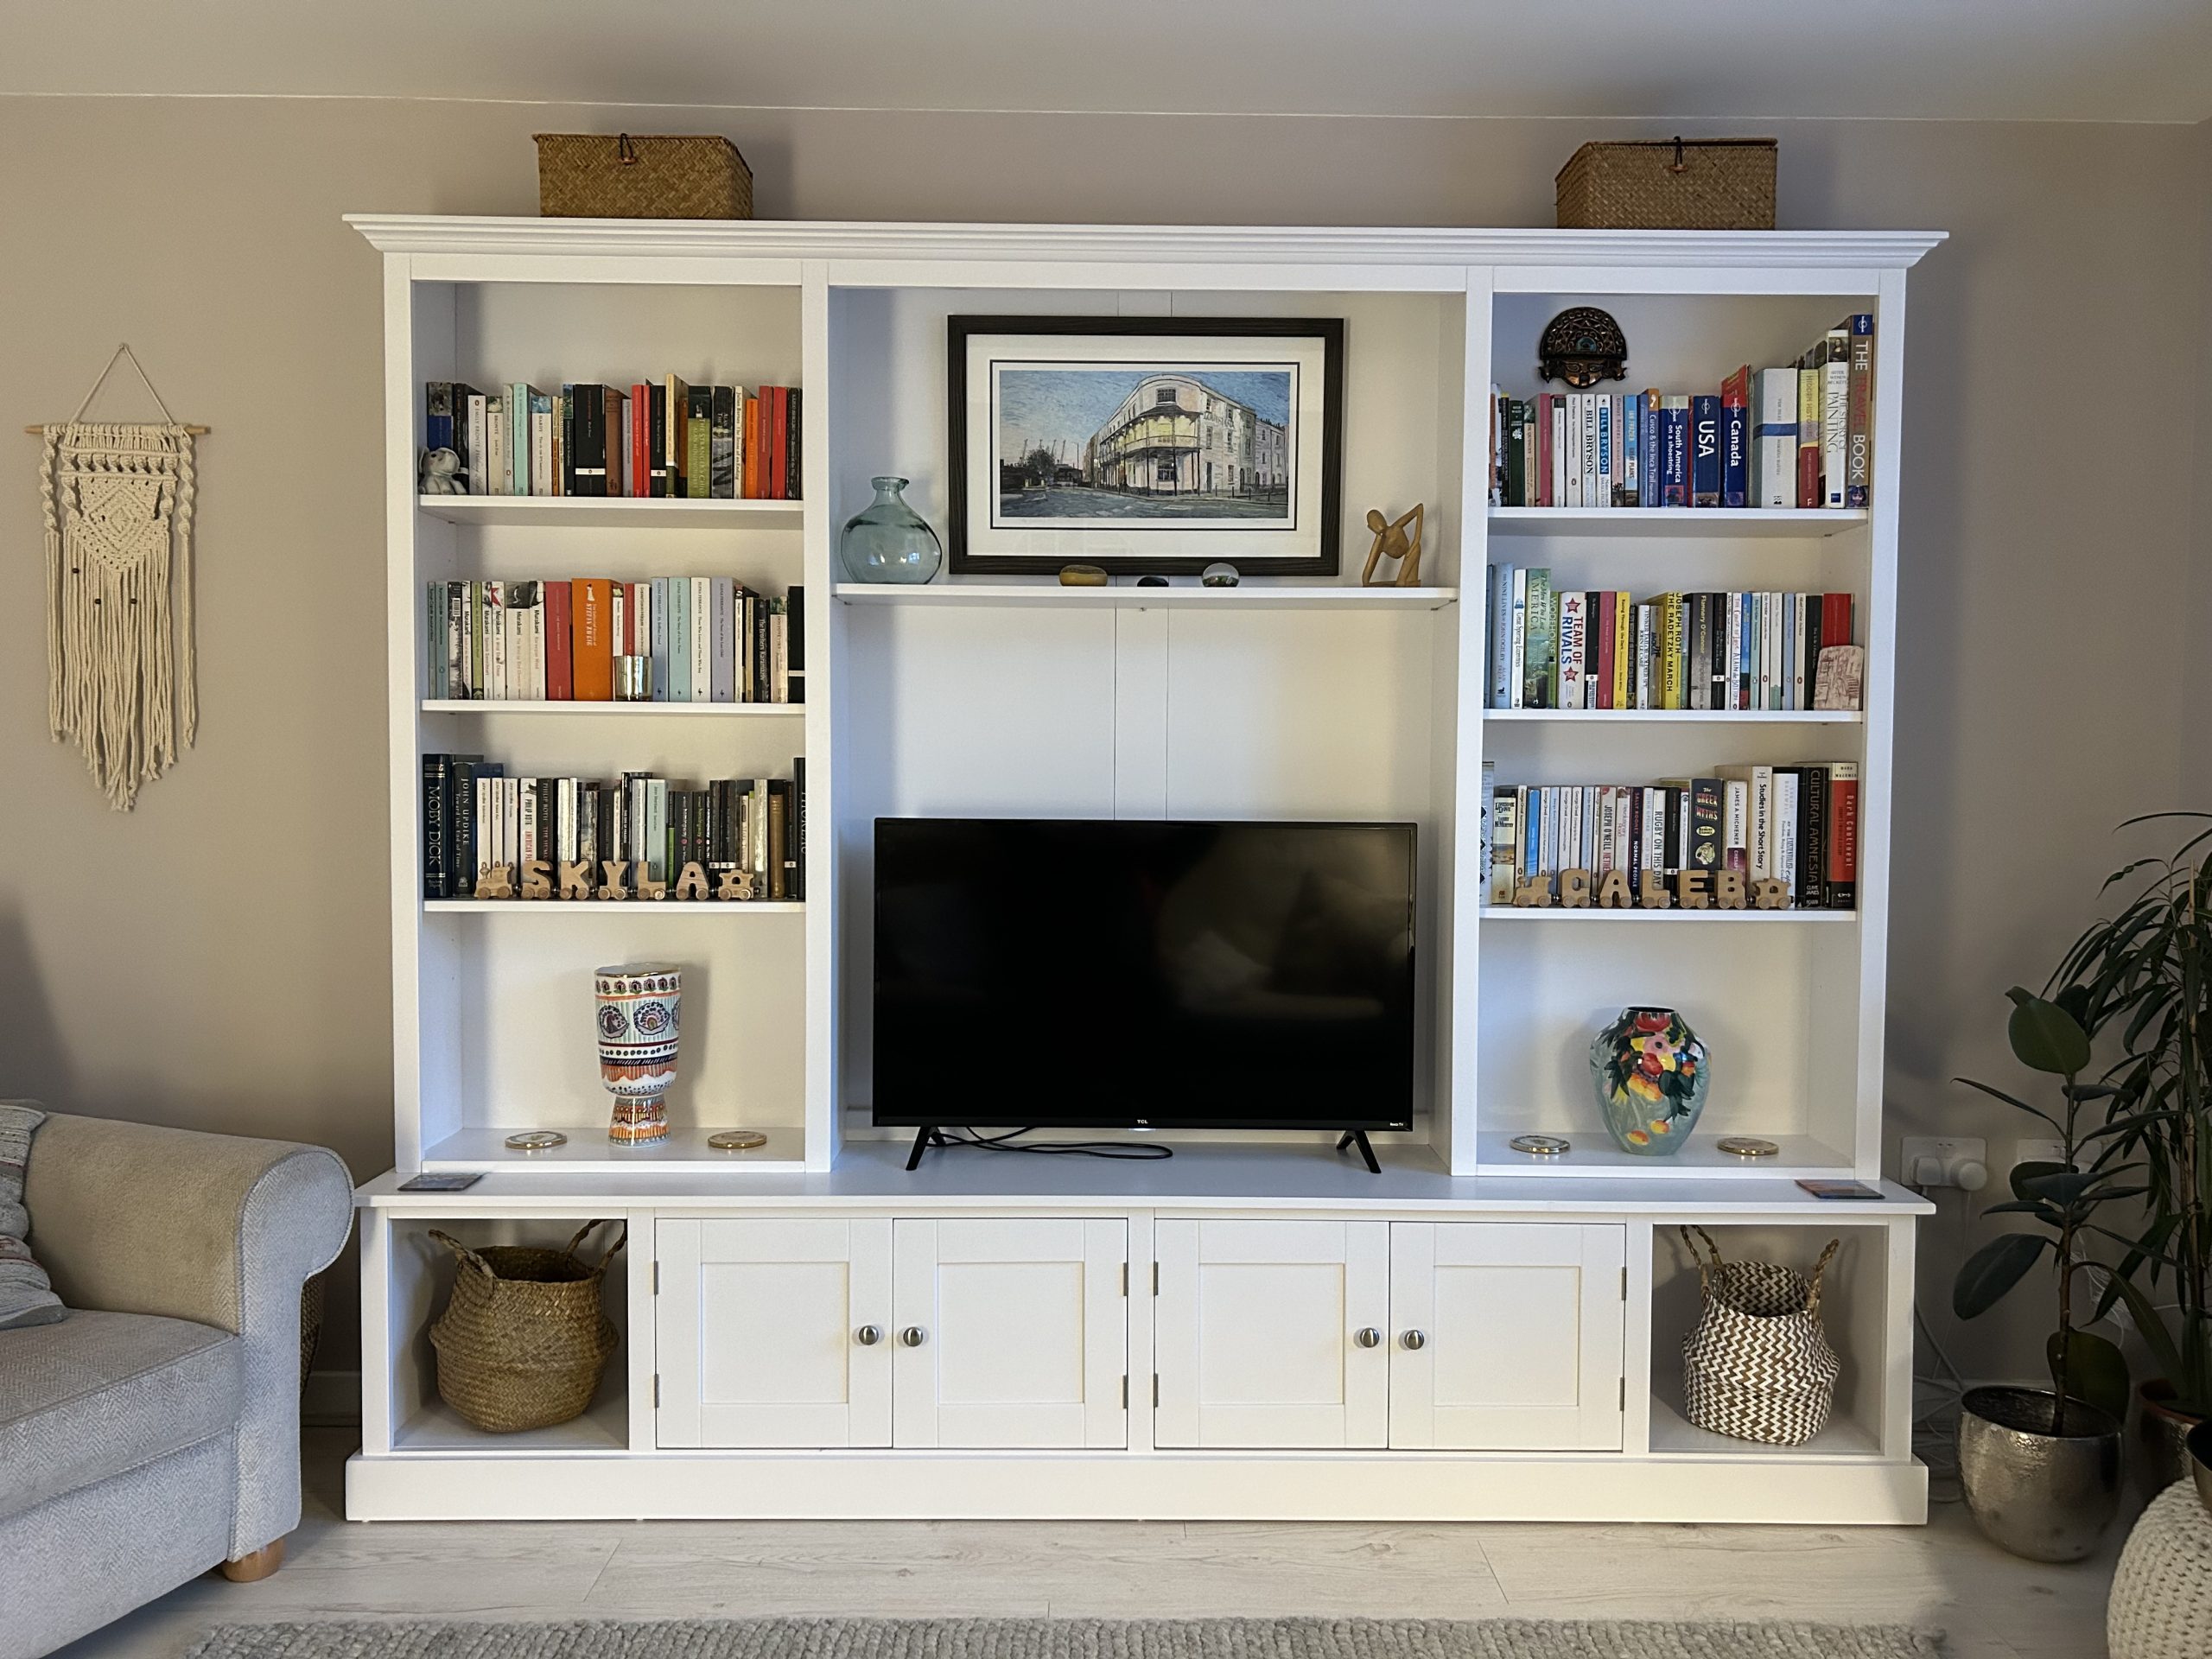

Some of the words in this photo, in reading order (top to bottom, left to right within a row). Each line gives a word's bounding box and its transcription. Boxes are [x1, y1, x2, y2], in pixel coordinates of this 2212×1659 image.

[1855, 340, 1869, 371] THE
[1853, 374, 1867, 432] TRAVEL
[1600, 408, 1609, 429] BILL
[1668, 425, 1674, 434] on
[1827, 391, 1840, 454] PAINTING
[1675, 424, 1683, 448] South
[1698, 420, 1715, 458] USA
[1730, 420, 1742, 467] Canada
[1600, 431, 1609, 474] BRYSON
[1852, 434, 1866, 480] BOOK
[1675, 450, 1683, 483] America
[1530, 574, 1539, 631] AMERICA
[1515, 626, 1524, 645] Sporting
[1548, 596, 1556, 654] WODEHOUSE
[1573, 616, 1584, 646] TEAM
[1561, 616, 1573, 664] RIVALS
[1573, 651, 1583, 664] OF
[429, 785, 441, 827] MOBY
[1696, 792, 1718, 806] GREEK
[1758, 784, 1767, 810] Studies
[1809, 770, 1821, 826] CULTURAL
[1846, 795, 1854, 817] Dark
[681, 809, 690, 838] hemingway
[1604, 804, 1612, 826] JOSEPH
[1655, 811, 1663, 836] RUGBY
[1695, 807, 1718, 821] MYTHS
[1758, 818, 1766, 830] the
[428, 830, 441, 866] DICK
[524, 830, 533, 853] AMERICAN
[1603, 829, 1611, 850] O'NEILL
[1654, 838, 1662, 850] ON
[1757, 831, 1766, 849] Short
[1844, 820, 1854, 868] Continent
[1653, 852, 1662, 868] THIS
[1755, 850, 1765, 870] Story
[1808, 828, 1820, 884] AMNESIA
[1653, 870, 1662, 885] DAY
